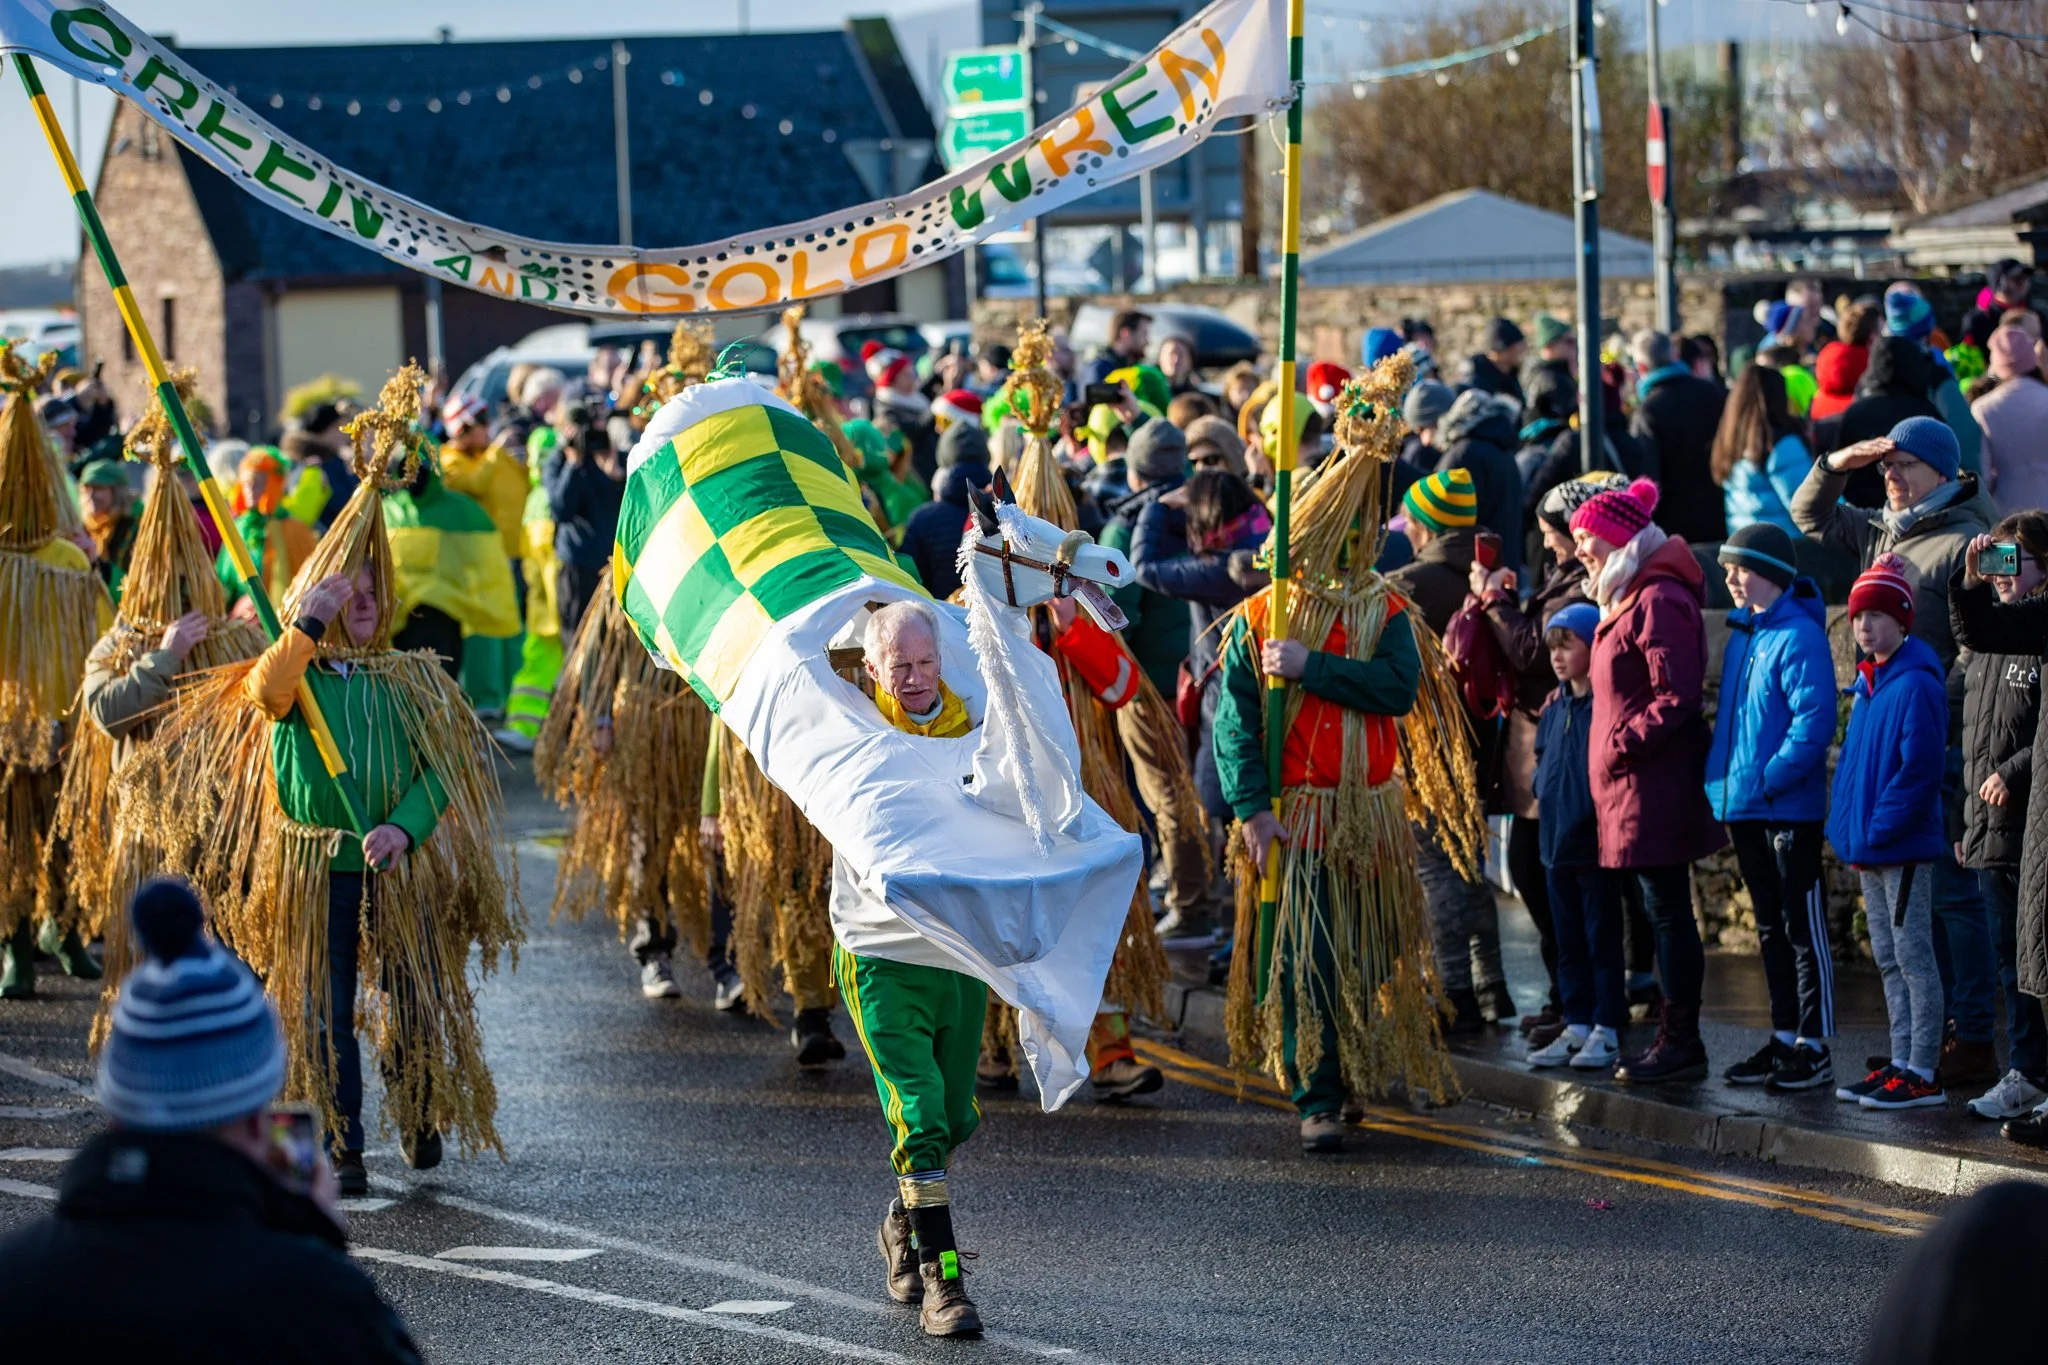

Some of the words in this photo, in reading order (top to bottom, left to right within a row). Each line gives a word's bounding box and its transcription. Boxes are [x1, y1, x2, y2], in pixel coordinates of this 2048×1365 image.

[51, 7, 383, 239] GREEN
[433, 254, 558, 301] AND
[607, 224, 911, 312] GOLD
[949, 28, 1225, 229] WREN
